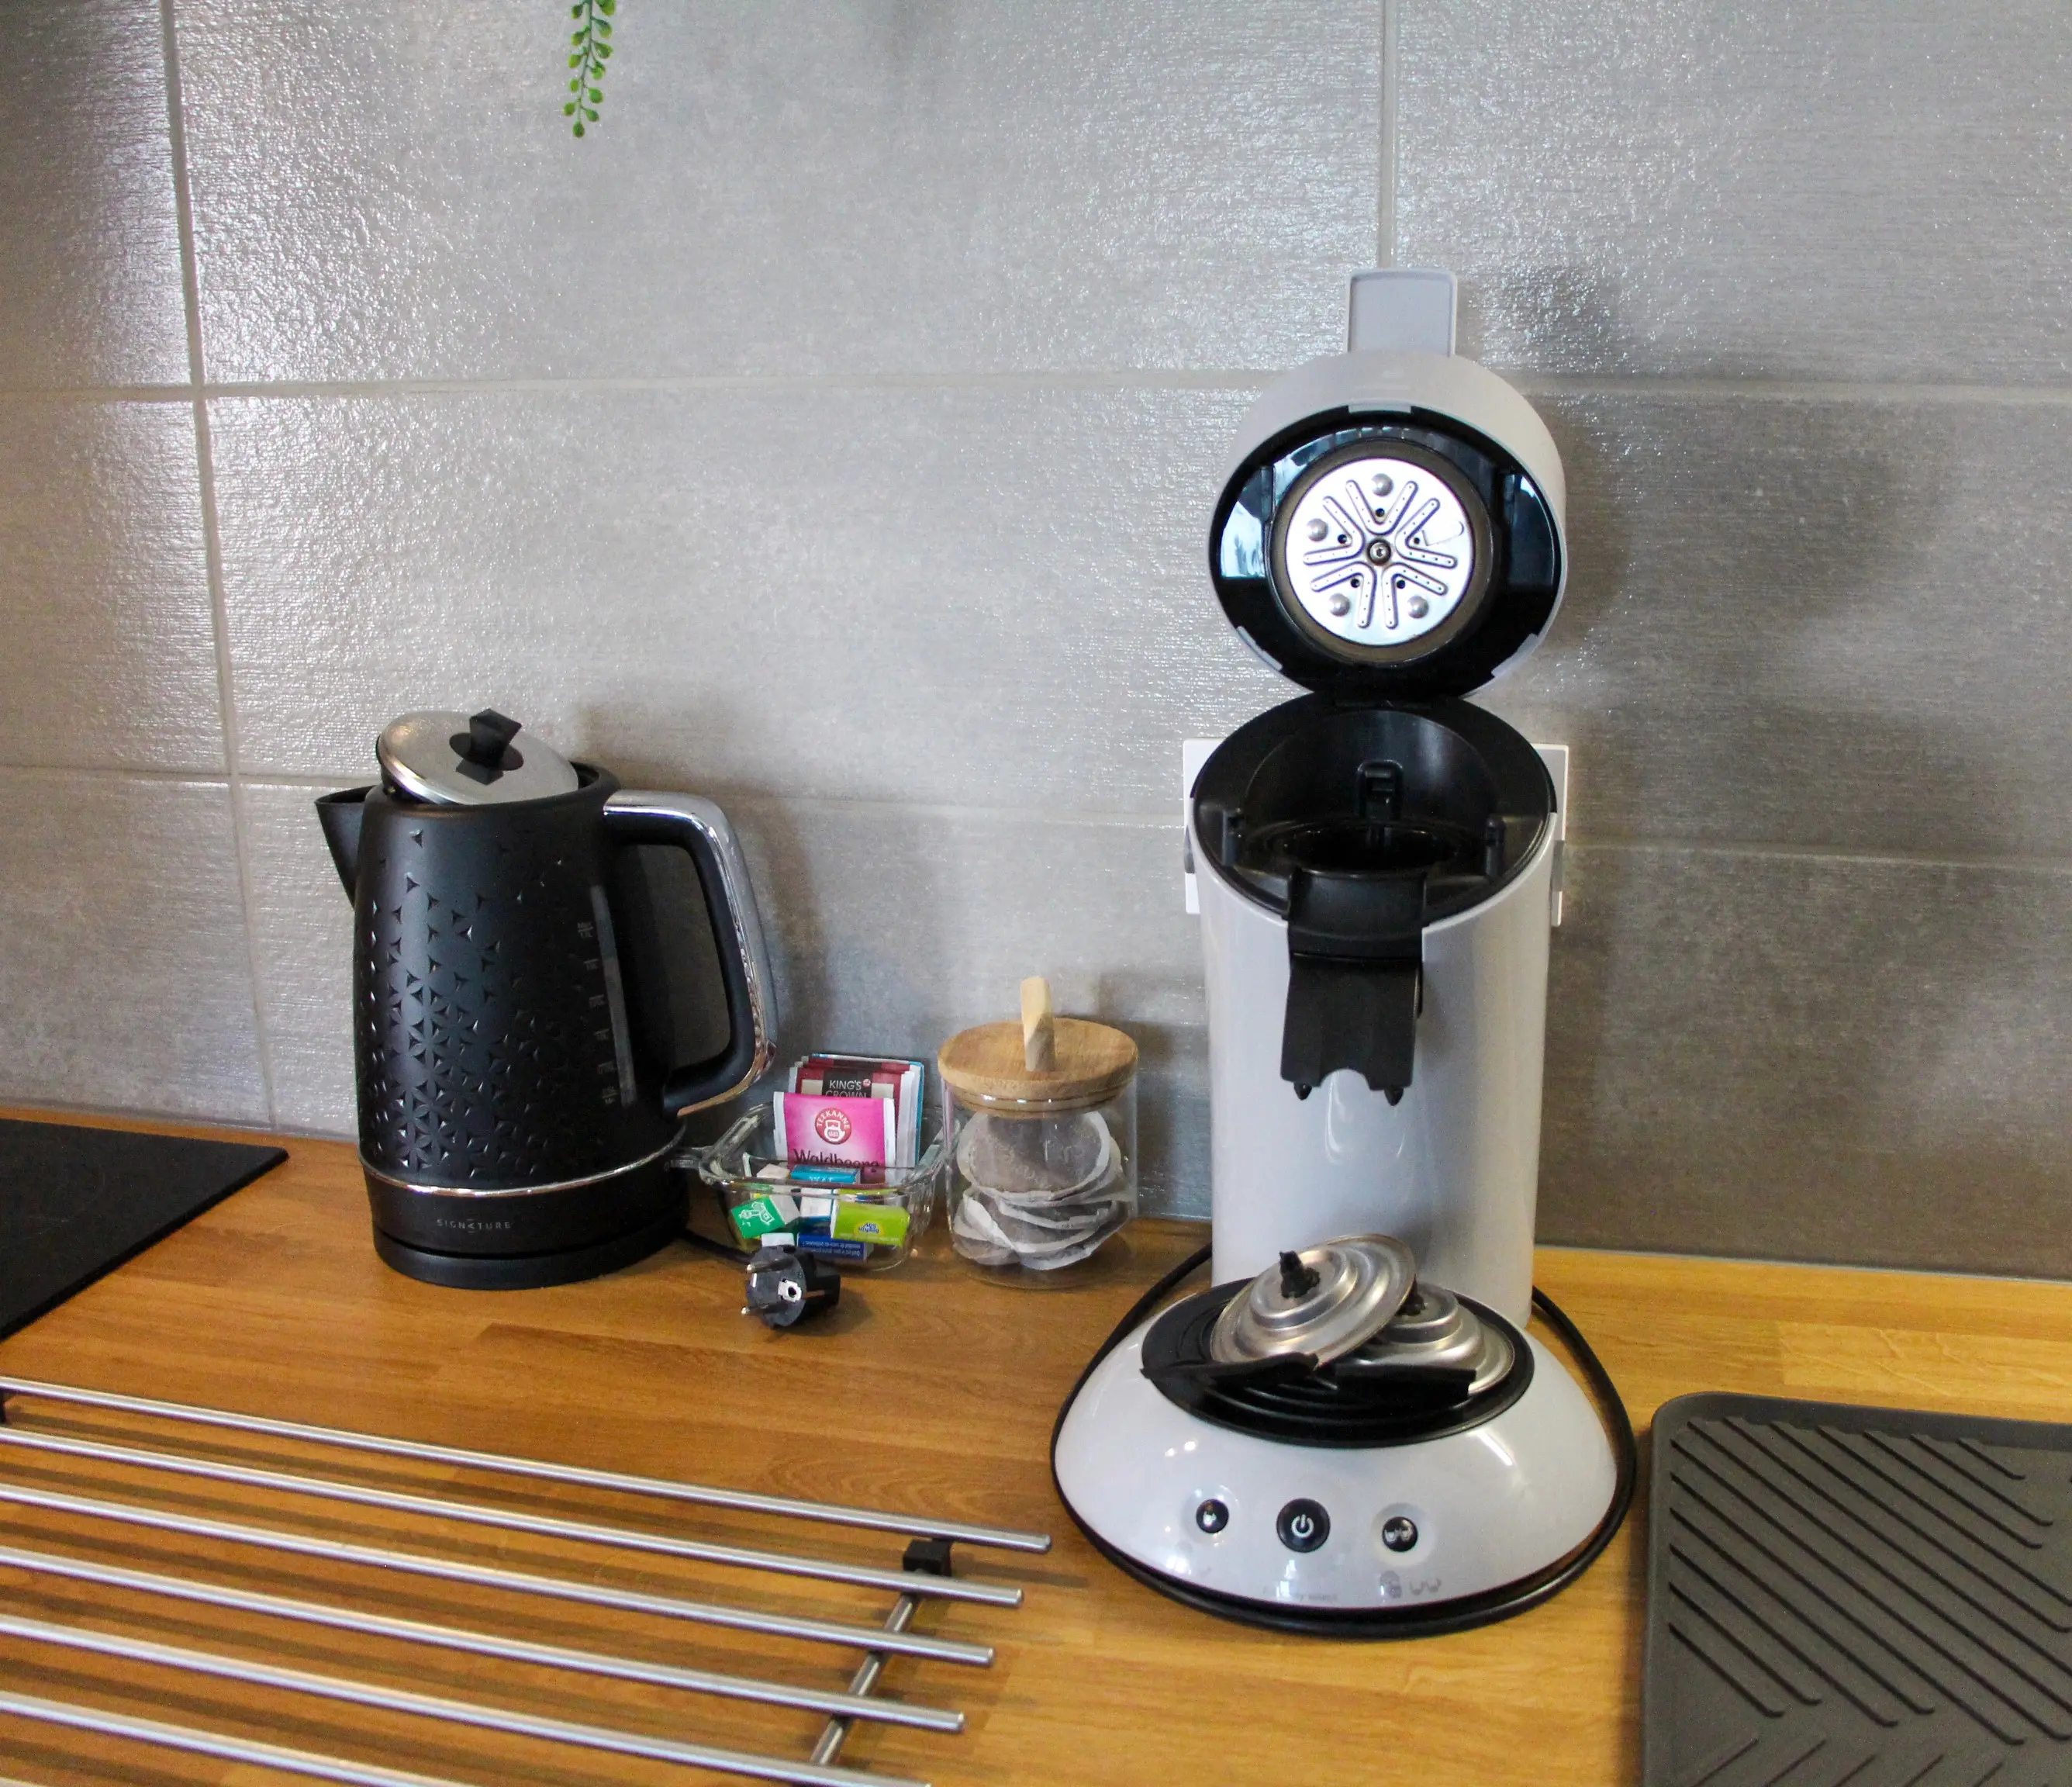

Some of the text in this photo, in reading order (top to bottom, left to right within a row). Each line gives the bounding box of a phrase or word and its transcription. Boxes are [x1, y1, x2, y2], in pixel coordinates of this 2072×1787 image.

[829, 1079, 862, 1091] KING'S
[817, 1110, 851, 1130] TEEKANNE
[436, 1218, 512, 1231] SIGNATURE
